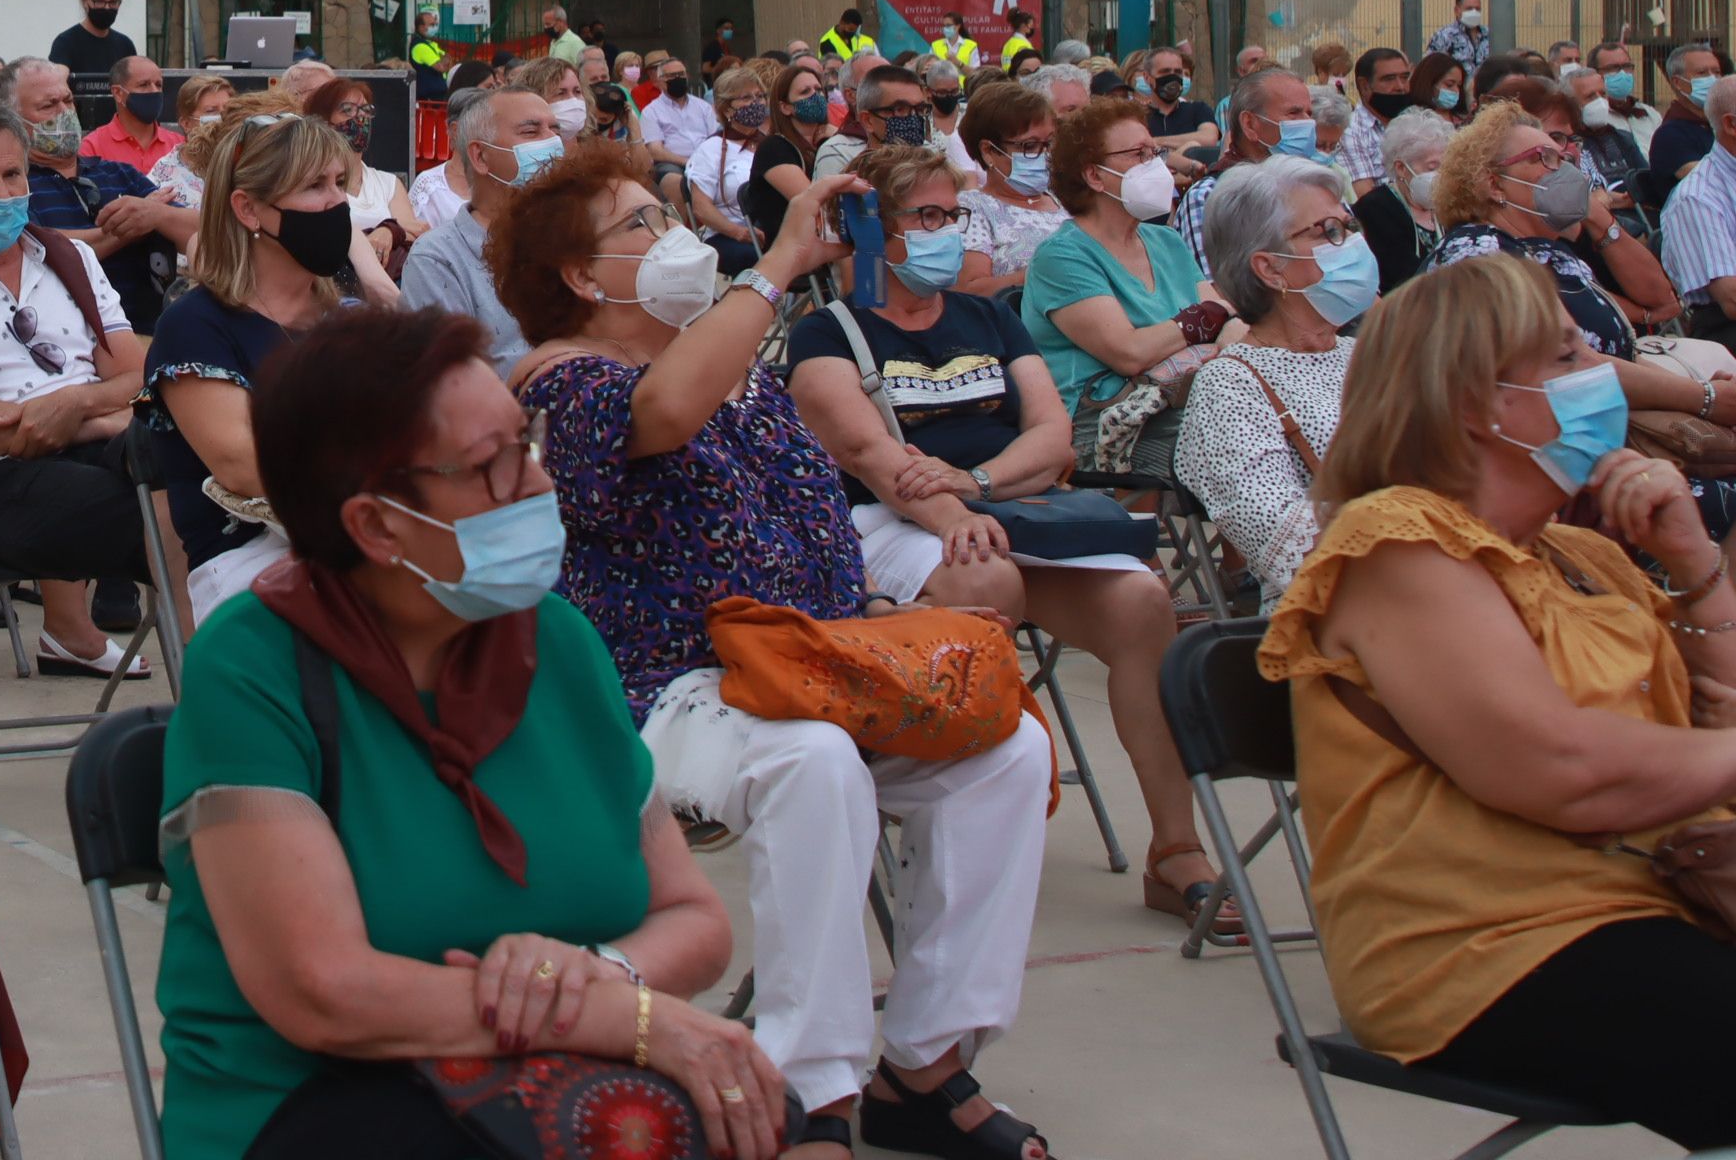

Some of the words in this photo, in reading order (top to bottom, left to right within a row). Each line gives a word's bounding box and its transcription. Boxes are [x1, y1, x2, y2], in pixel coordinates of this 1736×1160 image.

[905, 6, 942, 14] ENTITATS
[914, 16, 944, 24] CULTU
[962, 16, 991, 24] PULAR
[980, 26, 1013, 34] FAMILIA
[85, 82, 111, 90] YAMAH
